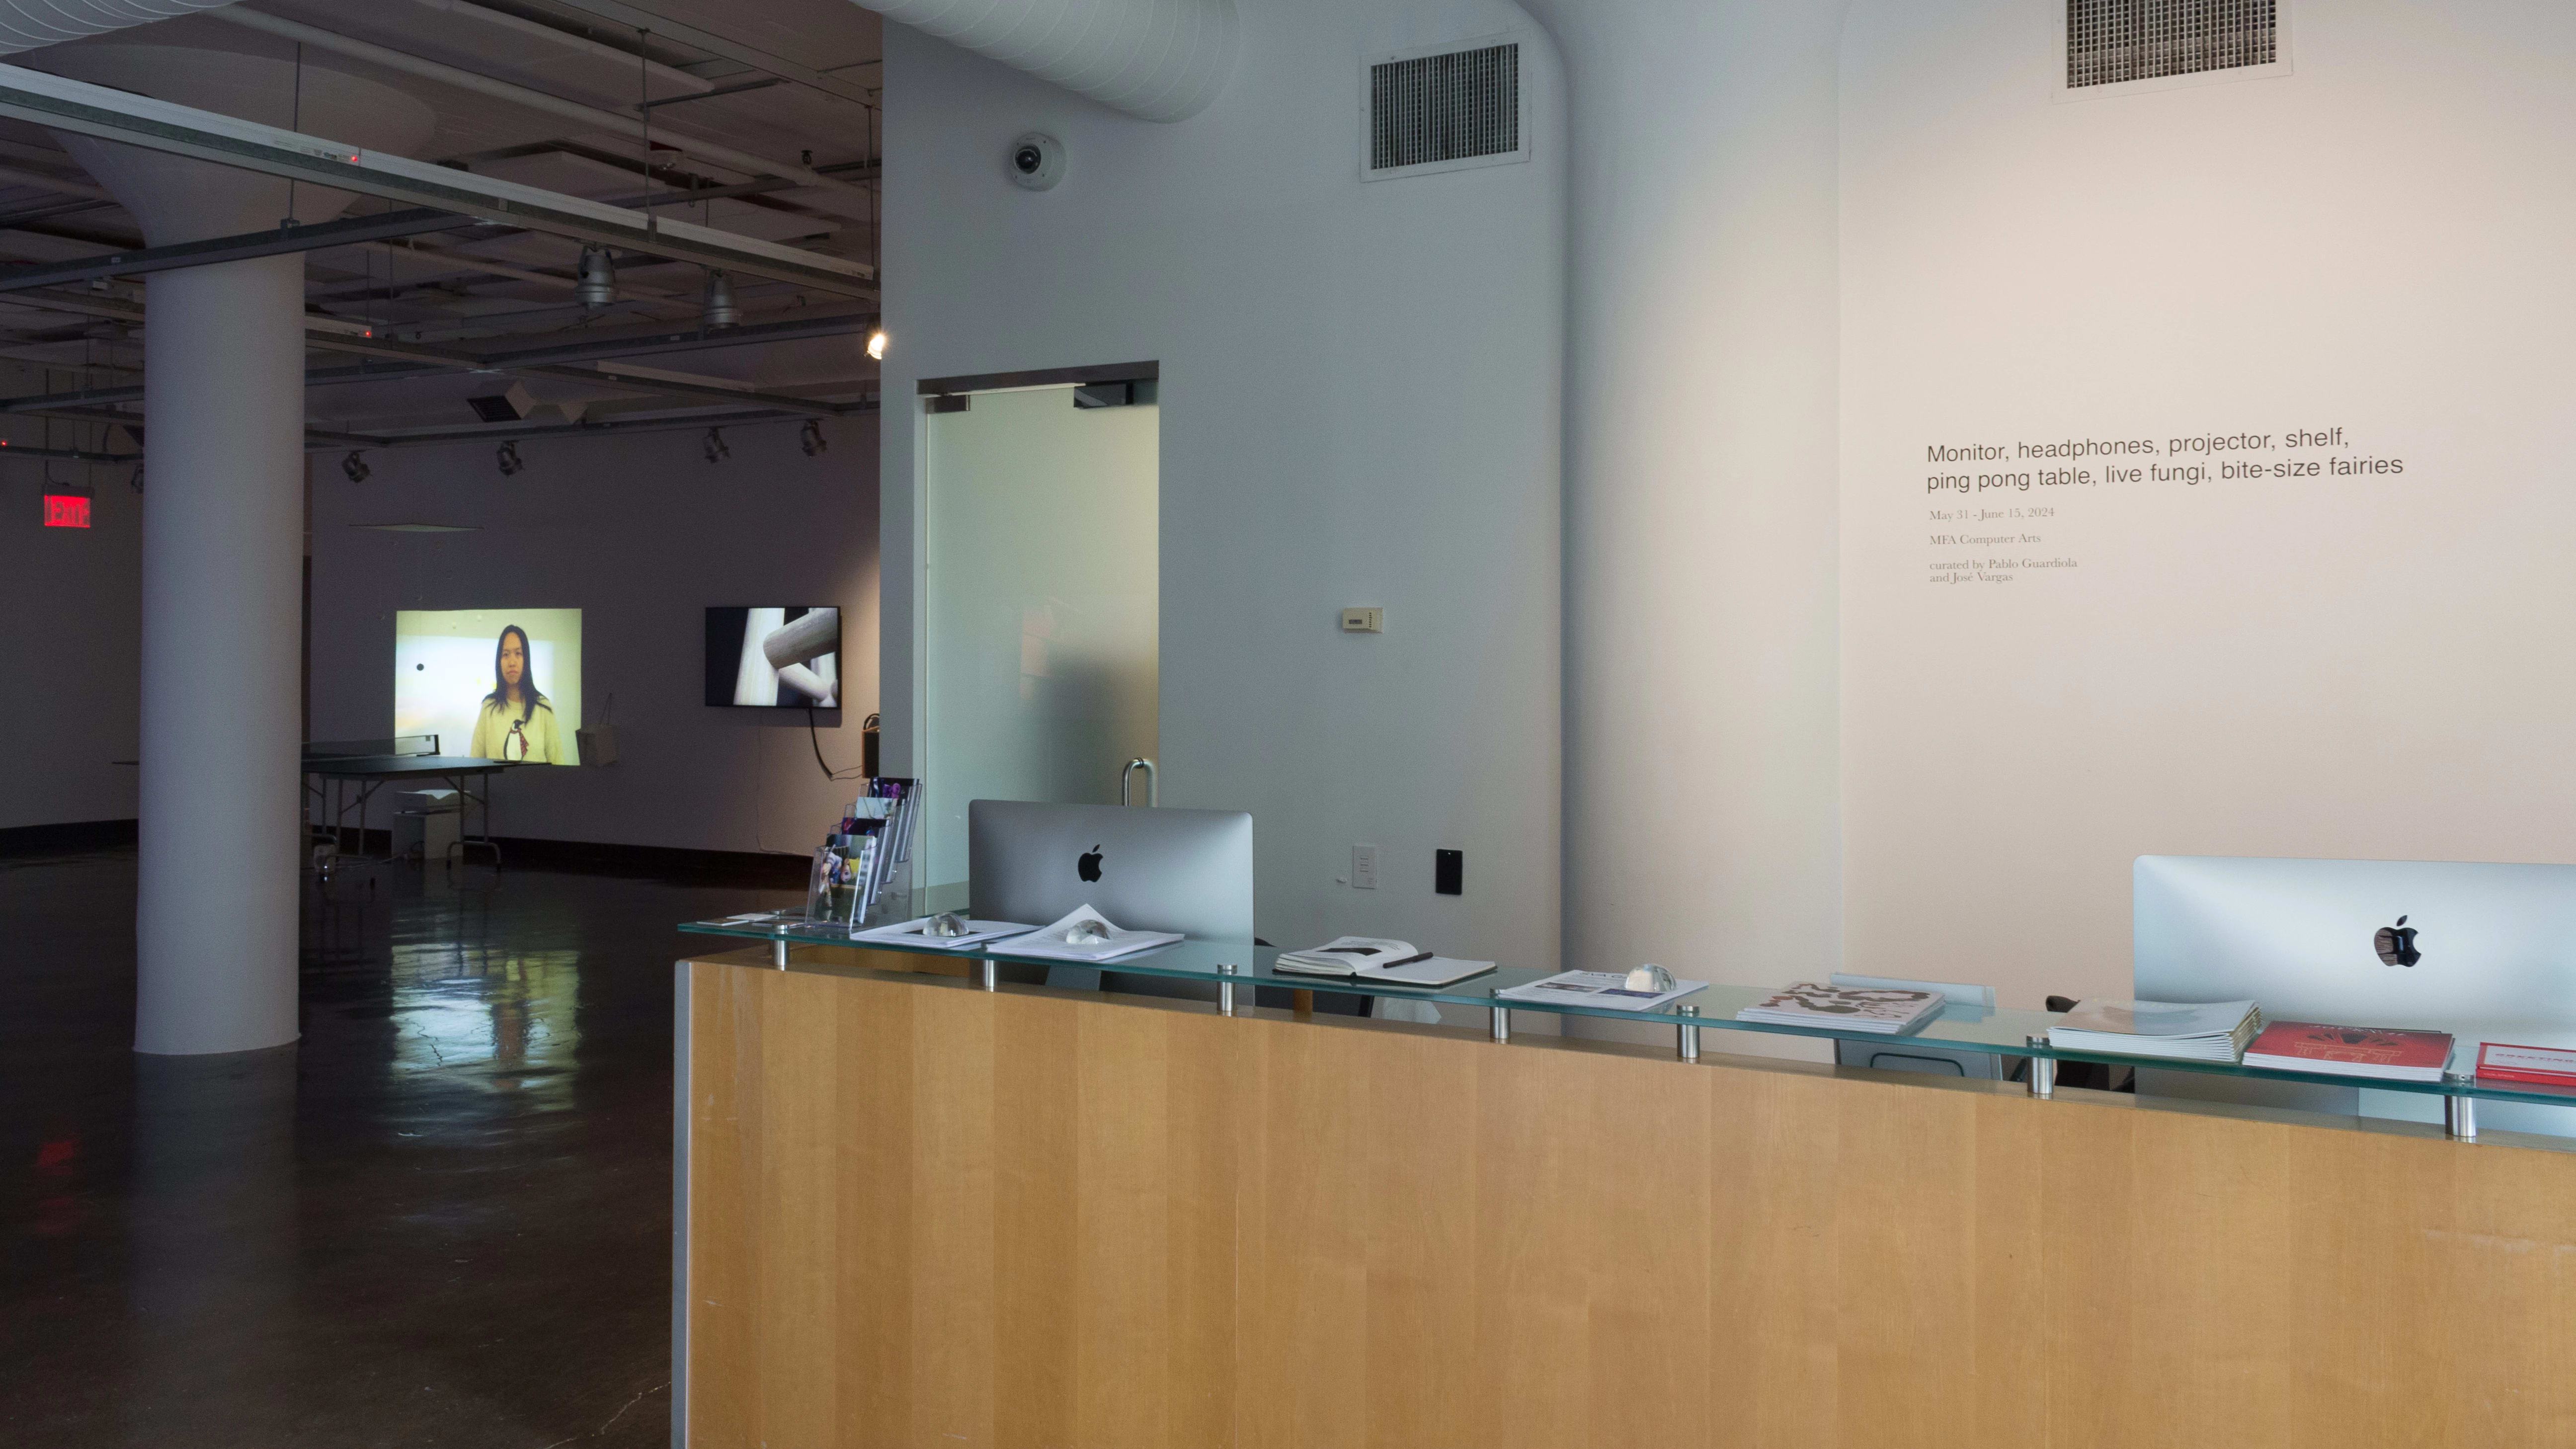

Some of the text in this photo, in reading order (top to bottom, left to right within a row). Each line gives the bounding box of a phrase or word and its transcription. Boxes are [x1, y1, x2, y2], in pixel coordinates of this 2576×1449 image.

[1928, 426, 2348, 463] Monitor, headphones, projector, shelf,
[1928, 455, 2404, 494] ping pong table, live fungi, bite-size fairies
[1929, 510, 1953, 522] May
[1957, 509, 1968, 519] 31
[1978, 508, 2004, 522] June
[2009, 508, 2024, 519] 15,
[2027, 507, 2055, 518] 2024
[1930, 533, 2041, 547] MFA Computer Arts
[1929, 557, 2078, 572] curated by Pablo Guardiola
[1929, 571, 2013, 585] and José Vargas
[2495, 1053, 2576, 1063] GREETING
